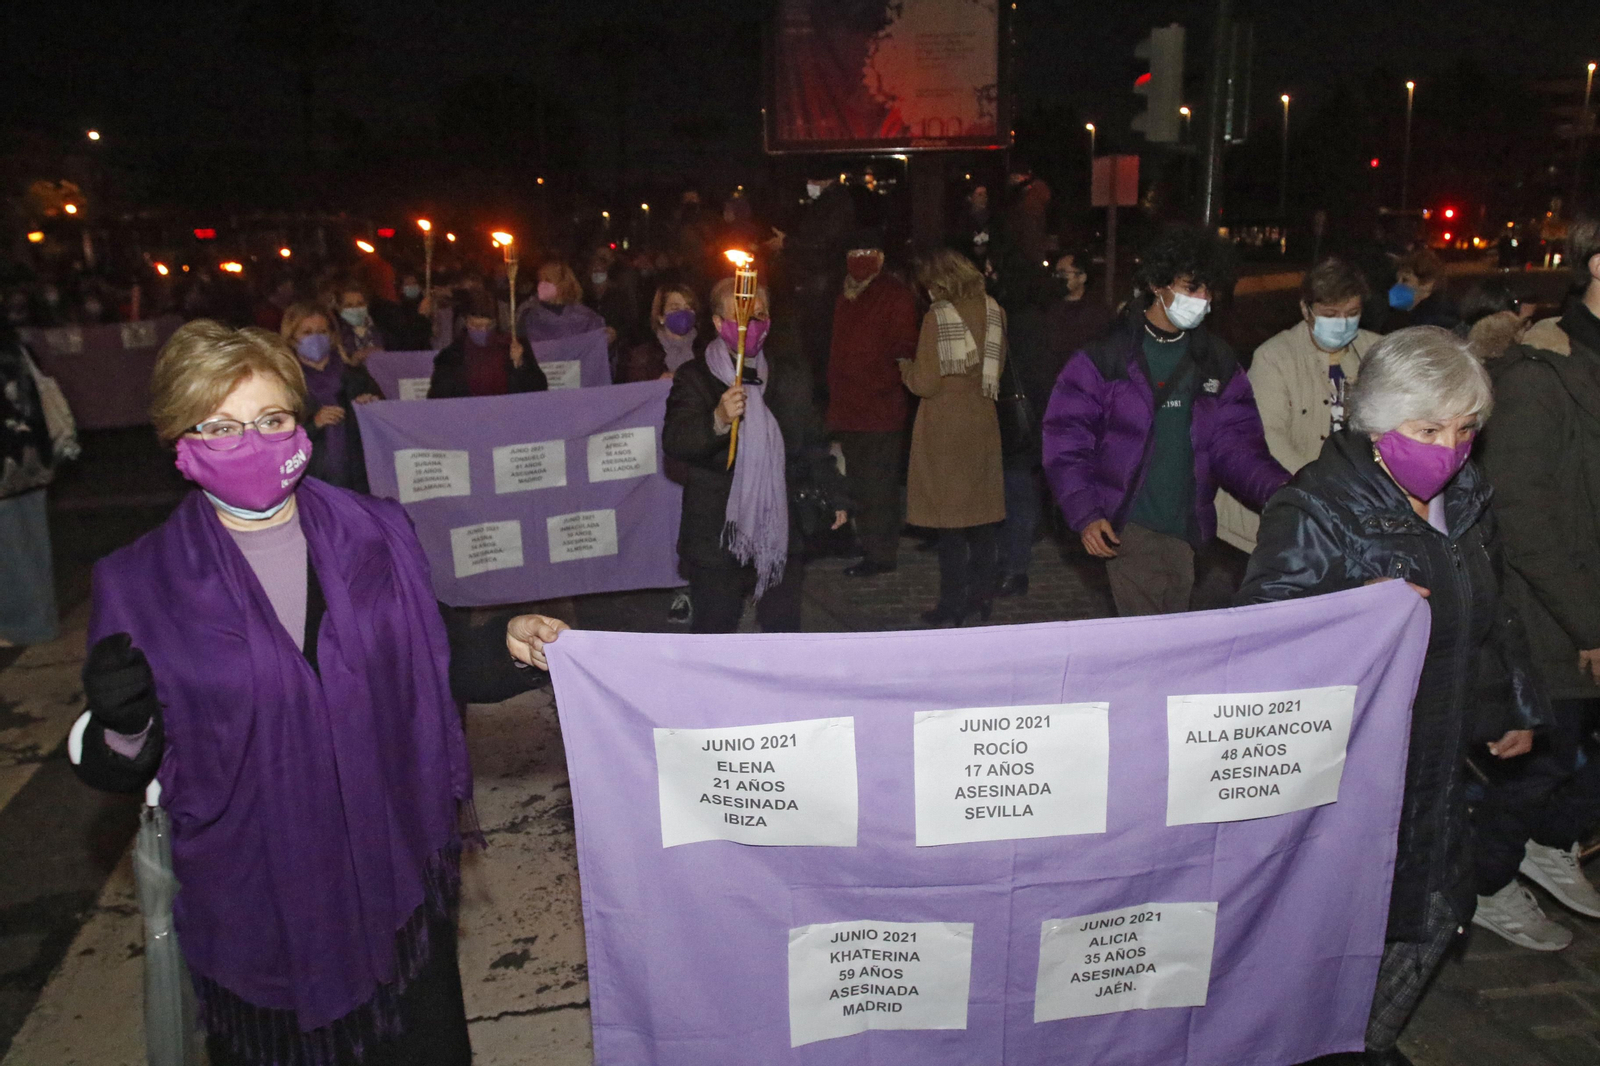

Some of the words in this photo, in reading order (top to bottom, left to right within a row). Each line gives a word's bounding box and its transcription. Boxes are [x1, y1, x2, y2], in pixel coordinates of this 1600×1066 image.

[511, 468, 546, 476] ASESINADA
[602, 464, 640, 472] VALLADOLID
[1214, 704, 1263, 718] JUNIO
[1269, 700, 1300, 714] 2021
[960, 718, 1010, 732] JUNIO
[1017, 716, 1049, 729] 2021
[1186, 730, 1228, 743] ALLA
[1234, 720, 1332, 740] BUKANCOVA
[702, 738, 754, 751] JUNIO
[761, 734, 795, 749] 2021
[975, 742, 1027, 755] ROCÍO
[1221, 749, 1237, 760] 48
[1242, 744, 1286, 758] AÑOS
[717, 761, 775, 773] ELENA
[965, 765, 981, 776] 17
[987, 762, 1034, 775] AÑOS
[1210, 763, 1301, 781] ASESINADA
[714, 778, 729, 789] 21
[736, 779, 785, 792] AÑOS
[955, 783, 1051, 799] ASESINADA
[1219, 784, 1280, 799] GIRONA
[700, 794, 798, 810] ASESINADA
[725, 813, 767, 826] IBIZA
[965, 805, 1033, 819] SEVILLA
[1080, 916, 1125, 932] JUNIO
[1129, 911, 1161, 924] 2021
[831, 929, 878, 943] JUNIO
[883, 931, 916, 942] 2021
[1089, 932, 1138, 948] ALICIA
[831, 949, 920, 963] KHATERINA
[1085, 953, 1100, 964] 35
[1104, 947, 1146, 962] AÑOS
[839, 969, 855, 981] 59
[859, 965, 903, 979] AÑOS
[1070, 963, 1156, 983] ASESINADA
[829, 984, 919, 1000] ASESINADA
[1095, 981, 1136, 997] JAÉN.
[843, 1001, 902, 1016] MADRID
